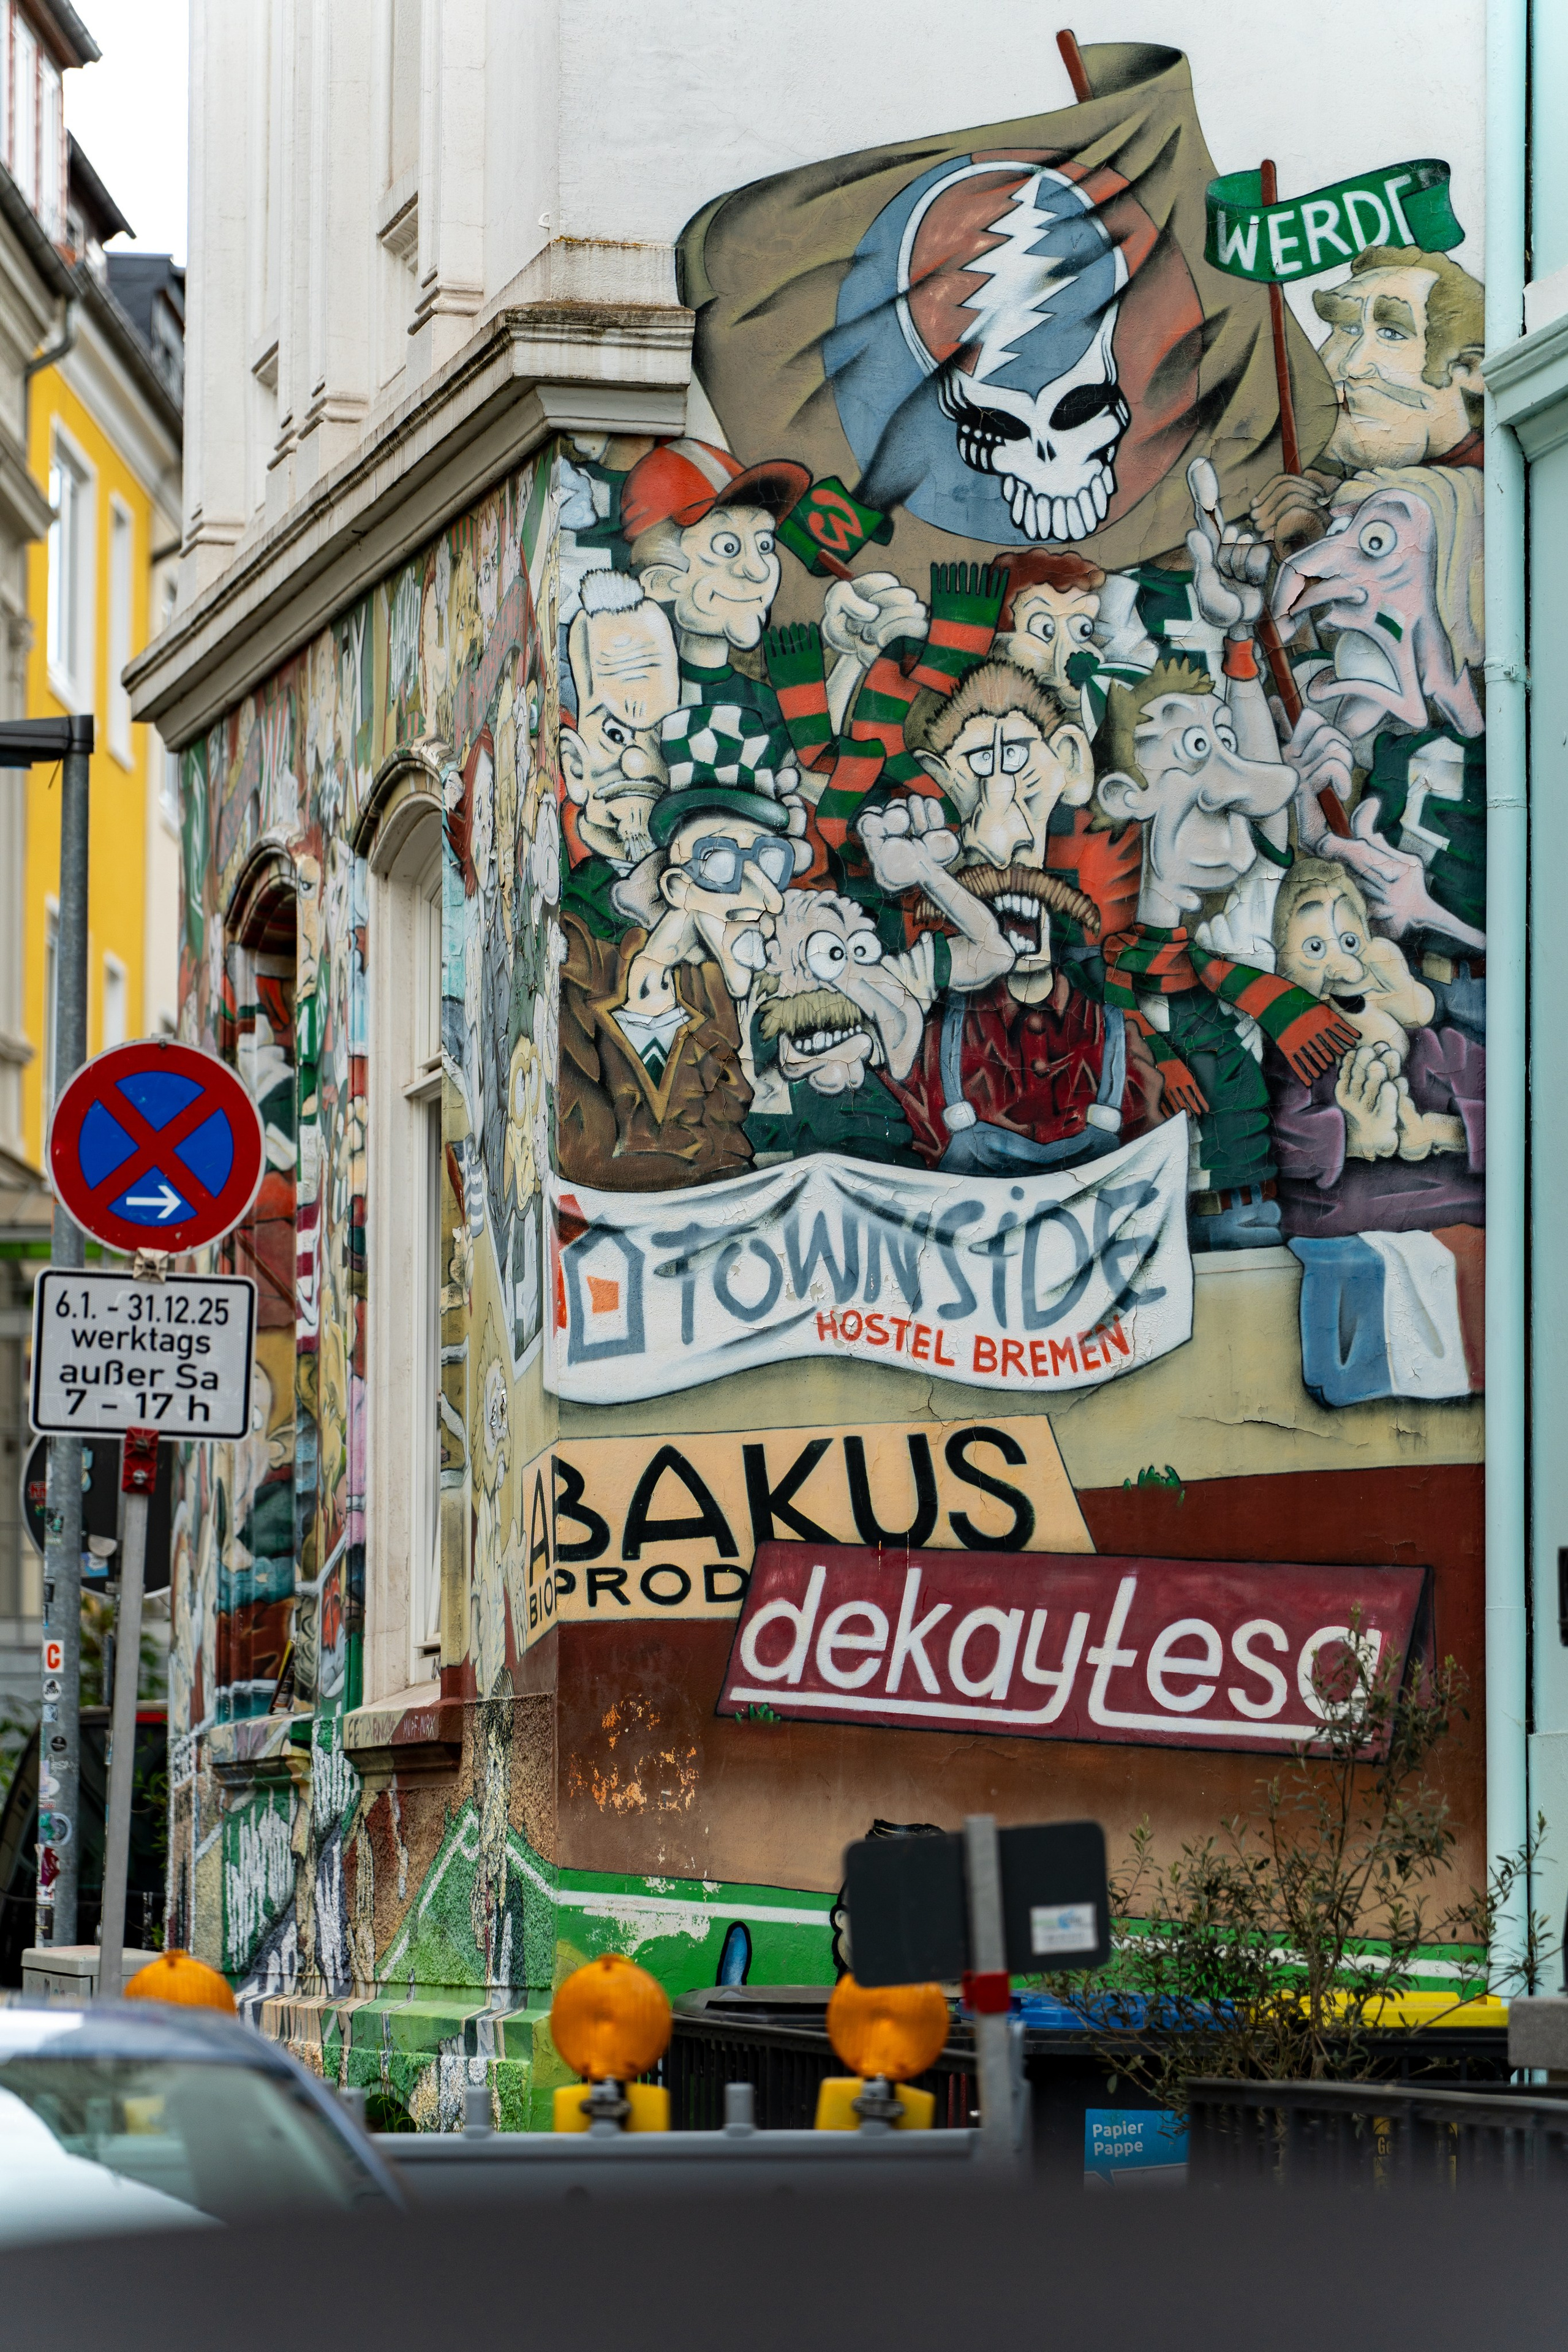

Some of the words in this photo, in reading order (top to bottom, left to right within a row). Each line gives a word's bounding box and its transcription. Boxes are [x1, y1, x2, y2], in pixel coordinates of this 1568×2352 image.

[56, 1289, 96, 1319] 6.1.
[127, 1292, 230, 1326] 31.12.25
[72, 1325, 211, 1359] werktags
[816, 1311, 954, 1367] HOSTEL
[972, 1314, 1129, 1378] BREMEN
[59, 1359, 165, 1387] außer
[176, 1363, 219, 1391] Sa
[66, 1388, 87, 1415] 7
[137, 1393, 173, 1420] 17
[189, 1394, 211, 1422] h
[529, 1426, 1036, 1588] ABAKUS
[732, 1564, 1382, 1743] dekaytesa
[1092, 2120, 1144, 2139] Papier
[1093, 2141, 1144, 2158] Pappe
